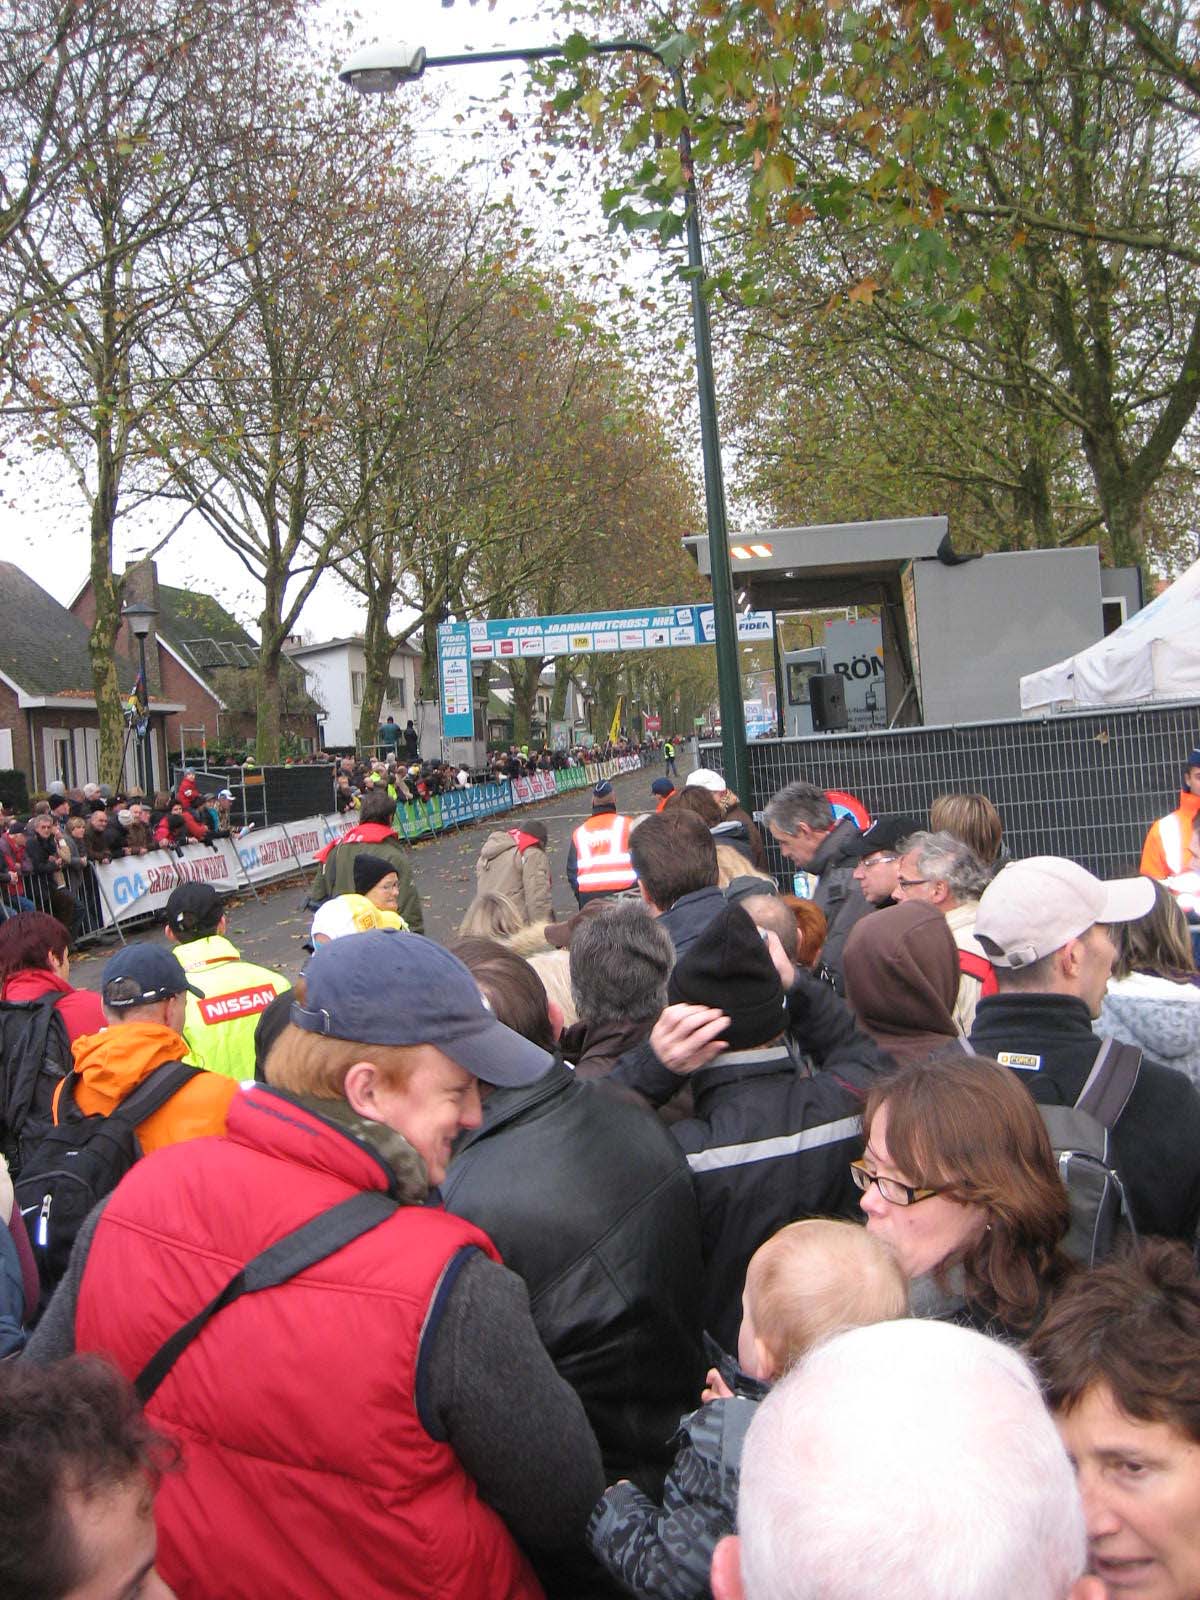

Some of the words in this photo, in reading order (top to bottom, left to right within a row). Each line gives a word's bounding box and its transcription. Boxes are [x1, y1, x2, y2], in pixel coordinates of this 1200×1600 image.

[507, 625, 543, 637] FIDEA
[544, 618, 650, 634] JAARMARKTCROSS
[652, 616, 675, 627] NIEL
[738, 621, 770, 631] FIDEA
[147, 864, 174, 894] GAZET
[206, 990, 274, 1018] NISSAN
